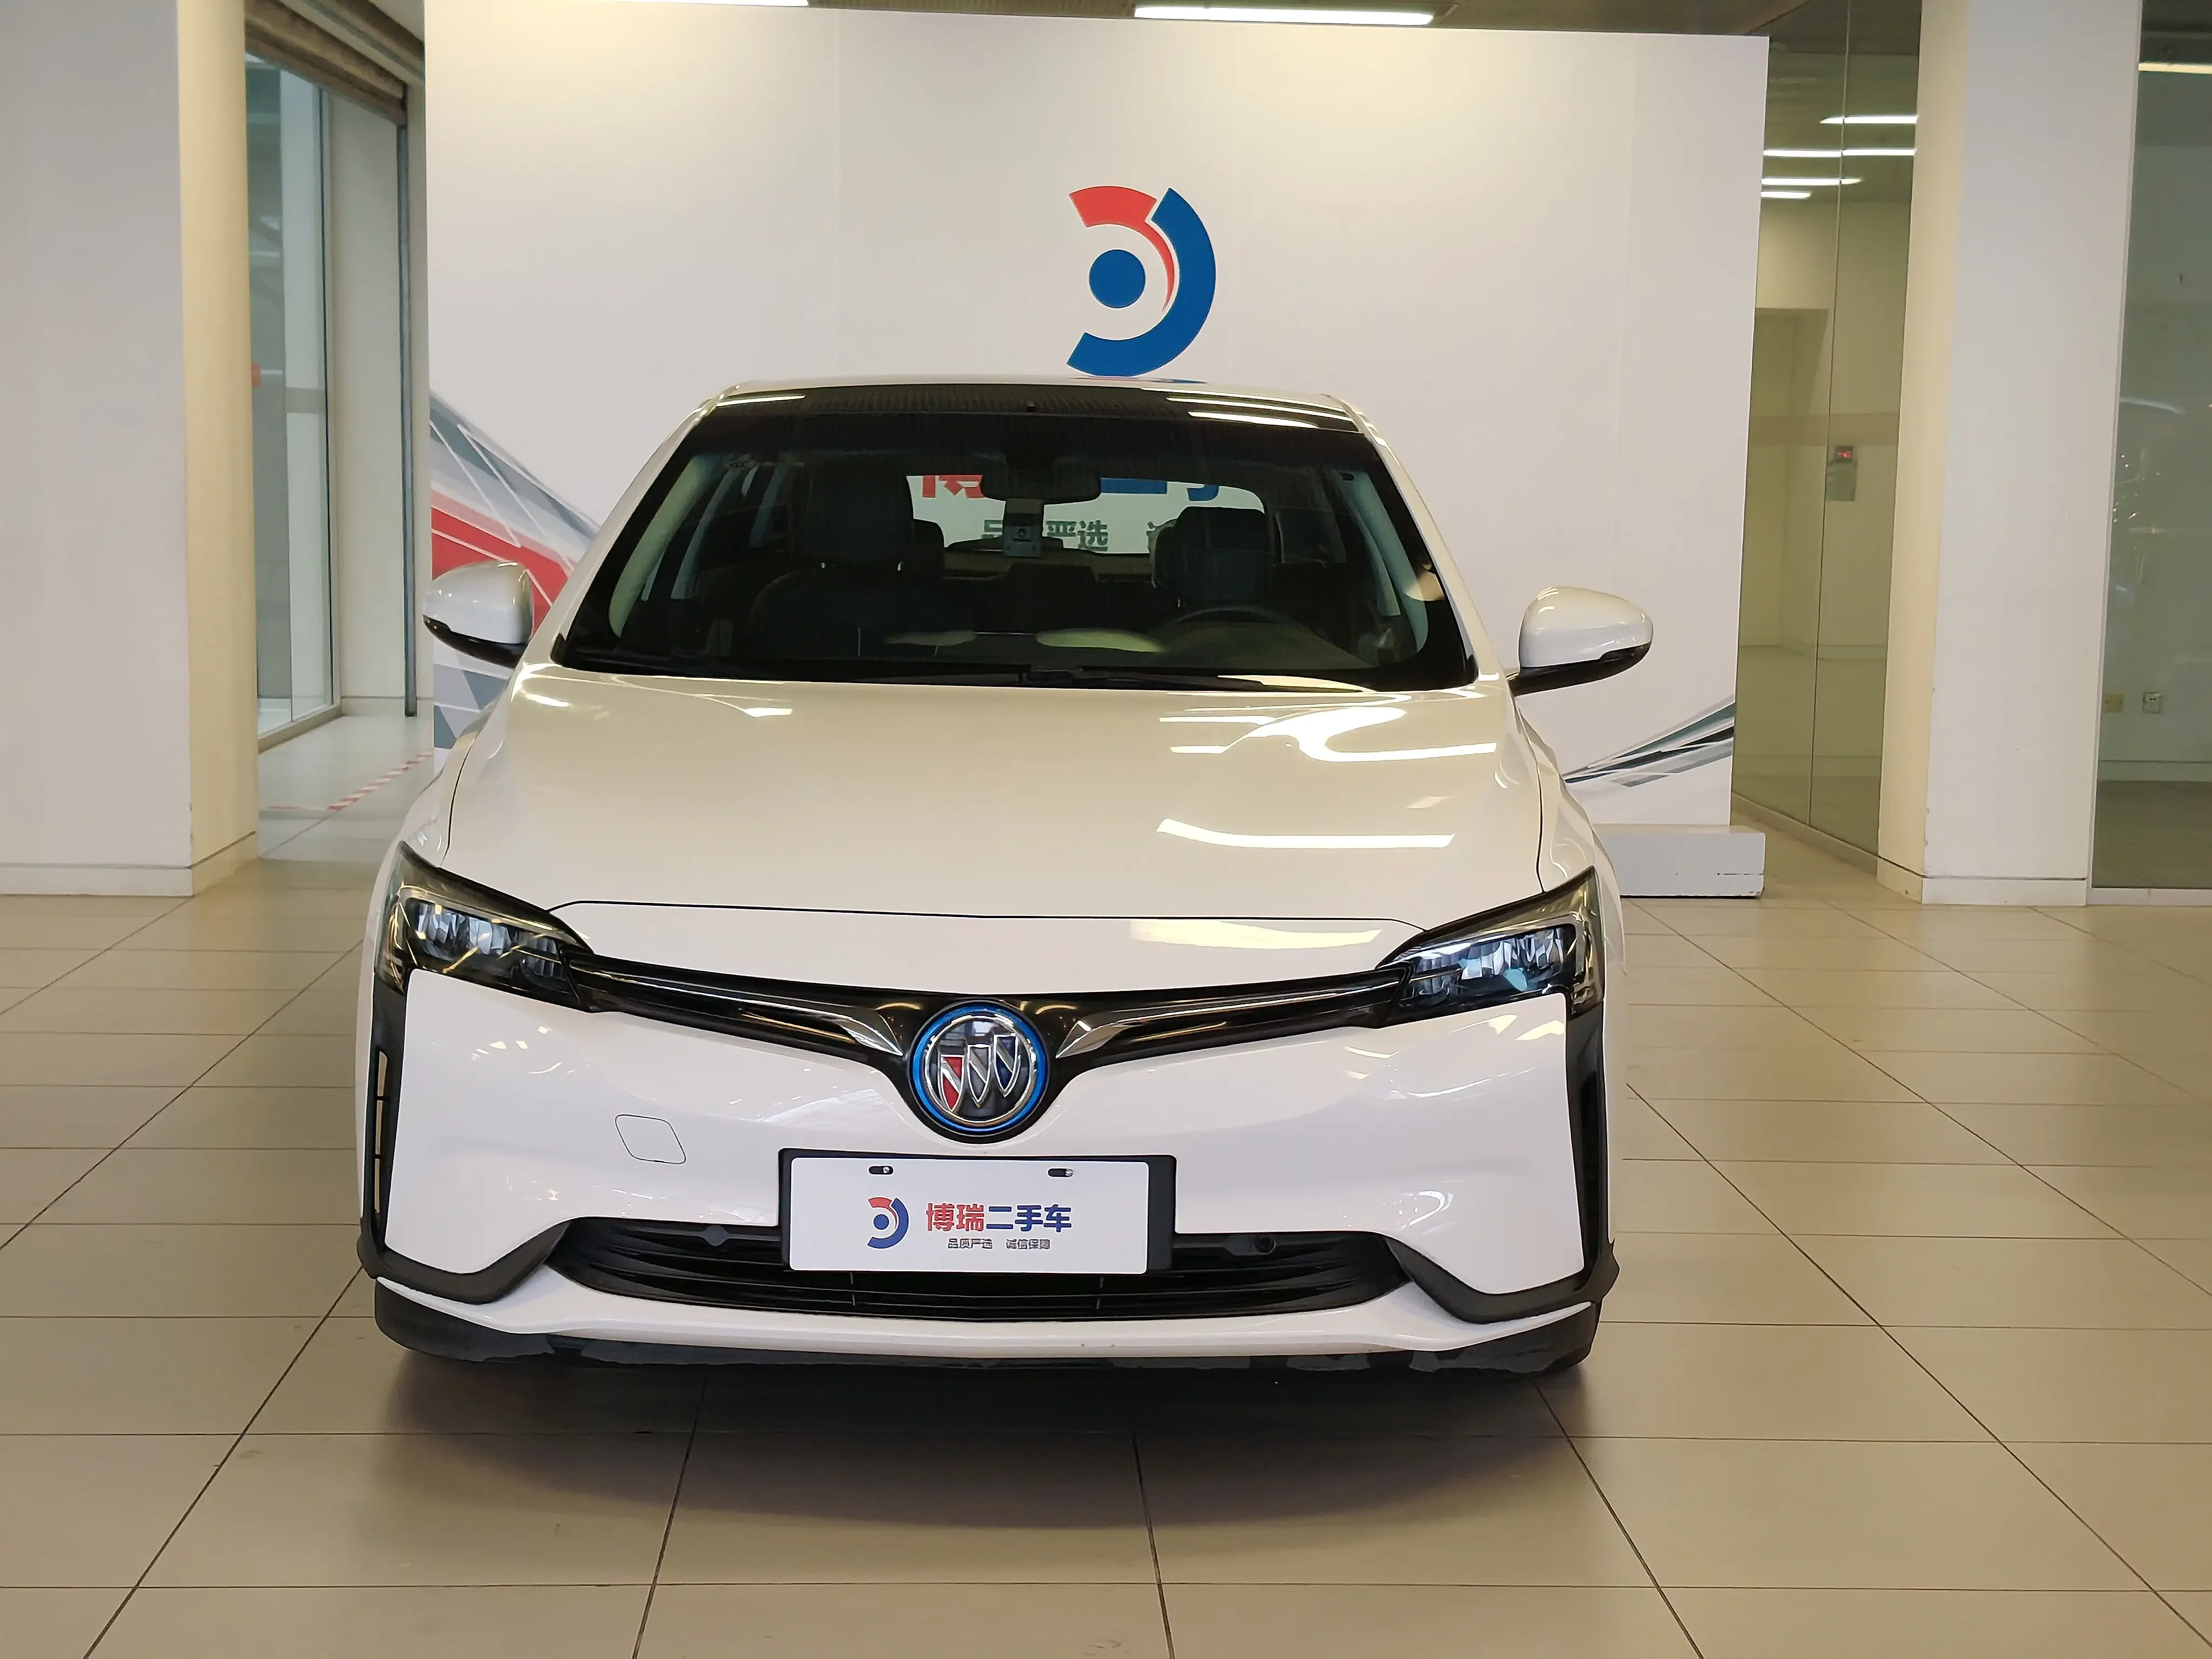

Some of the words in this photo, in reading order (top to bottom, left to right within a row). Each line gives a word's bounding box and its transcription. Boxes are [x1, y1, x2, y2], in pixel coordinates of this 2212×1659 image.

[926, 1203, 1072, 1233] 博瑞二手车
